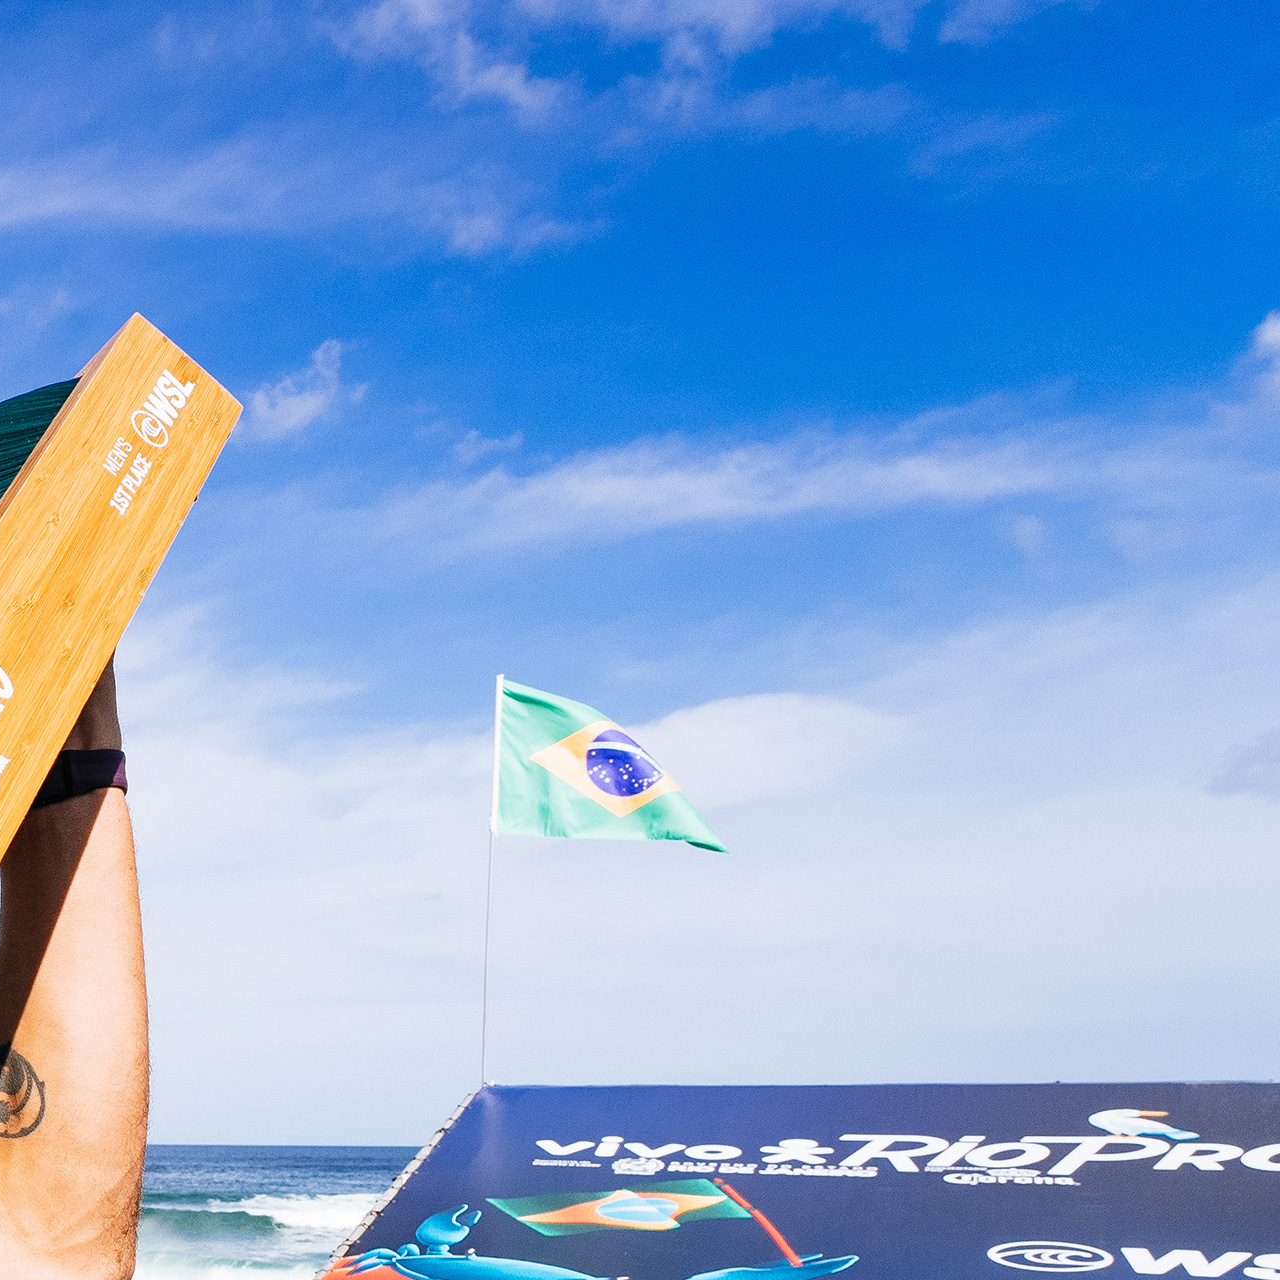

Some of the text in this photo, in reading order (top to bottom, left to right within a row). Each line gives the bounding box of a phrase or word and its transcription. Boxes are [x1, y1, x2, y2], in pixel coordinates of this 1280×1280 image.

[142, 368, 196, 428] WSL
[102, 436, 133, 477] MEN'S
[109, 452, 153, 516] 1ST PLACE
[535, 1136, 742, 1160] vivo
